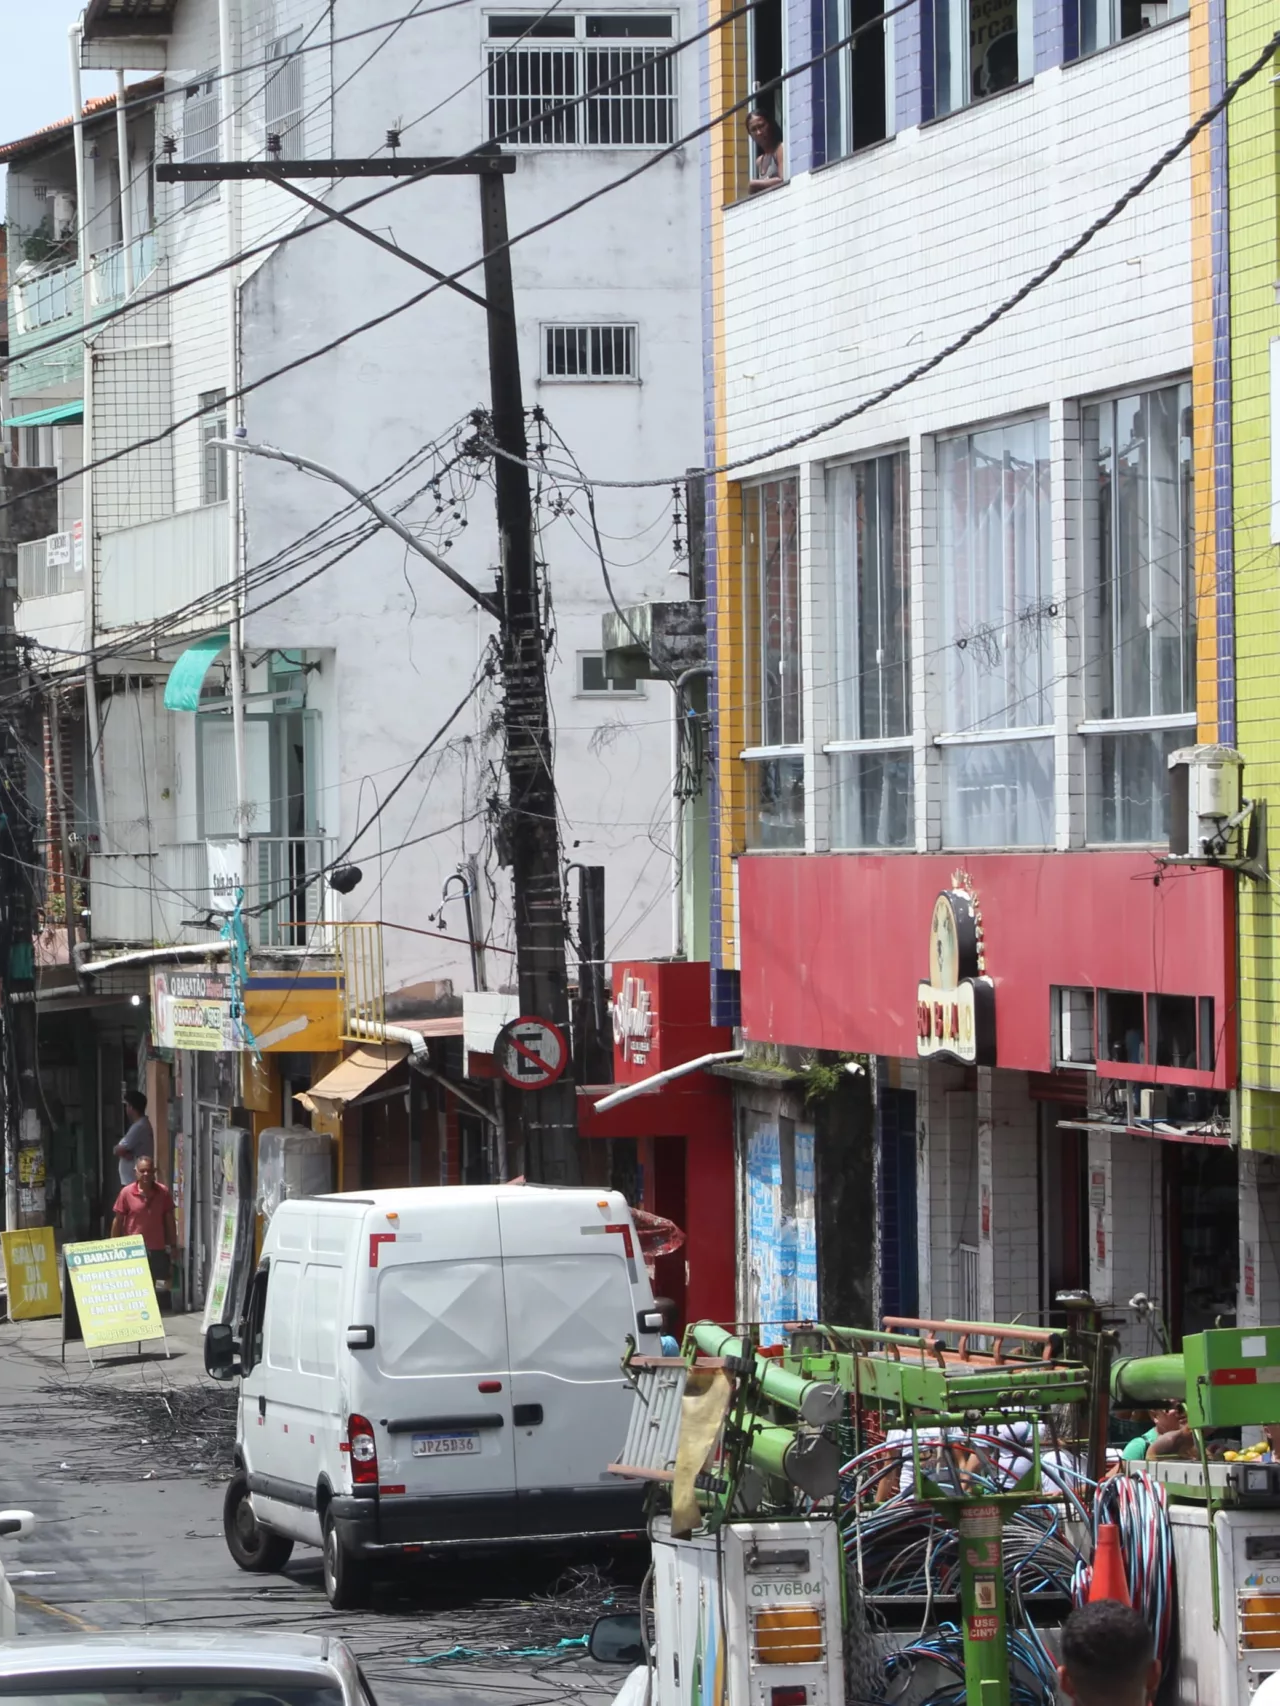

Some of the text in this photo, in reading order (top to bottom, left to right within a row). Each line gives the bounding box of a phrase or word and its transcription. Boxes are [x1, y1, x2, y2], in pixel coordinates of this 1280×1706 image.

[73, 1256, 82, 1265] O
[83, 1249, 127, 1264] BARATÃO
[76, 1267, 144, 1282] EMPRÉSTIMO
[81, 1289, 150, 1305] PARCELAMOS
[974, 1619, 995, 1627] USE
